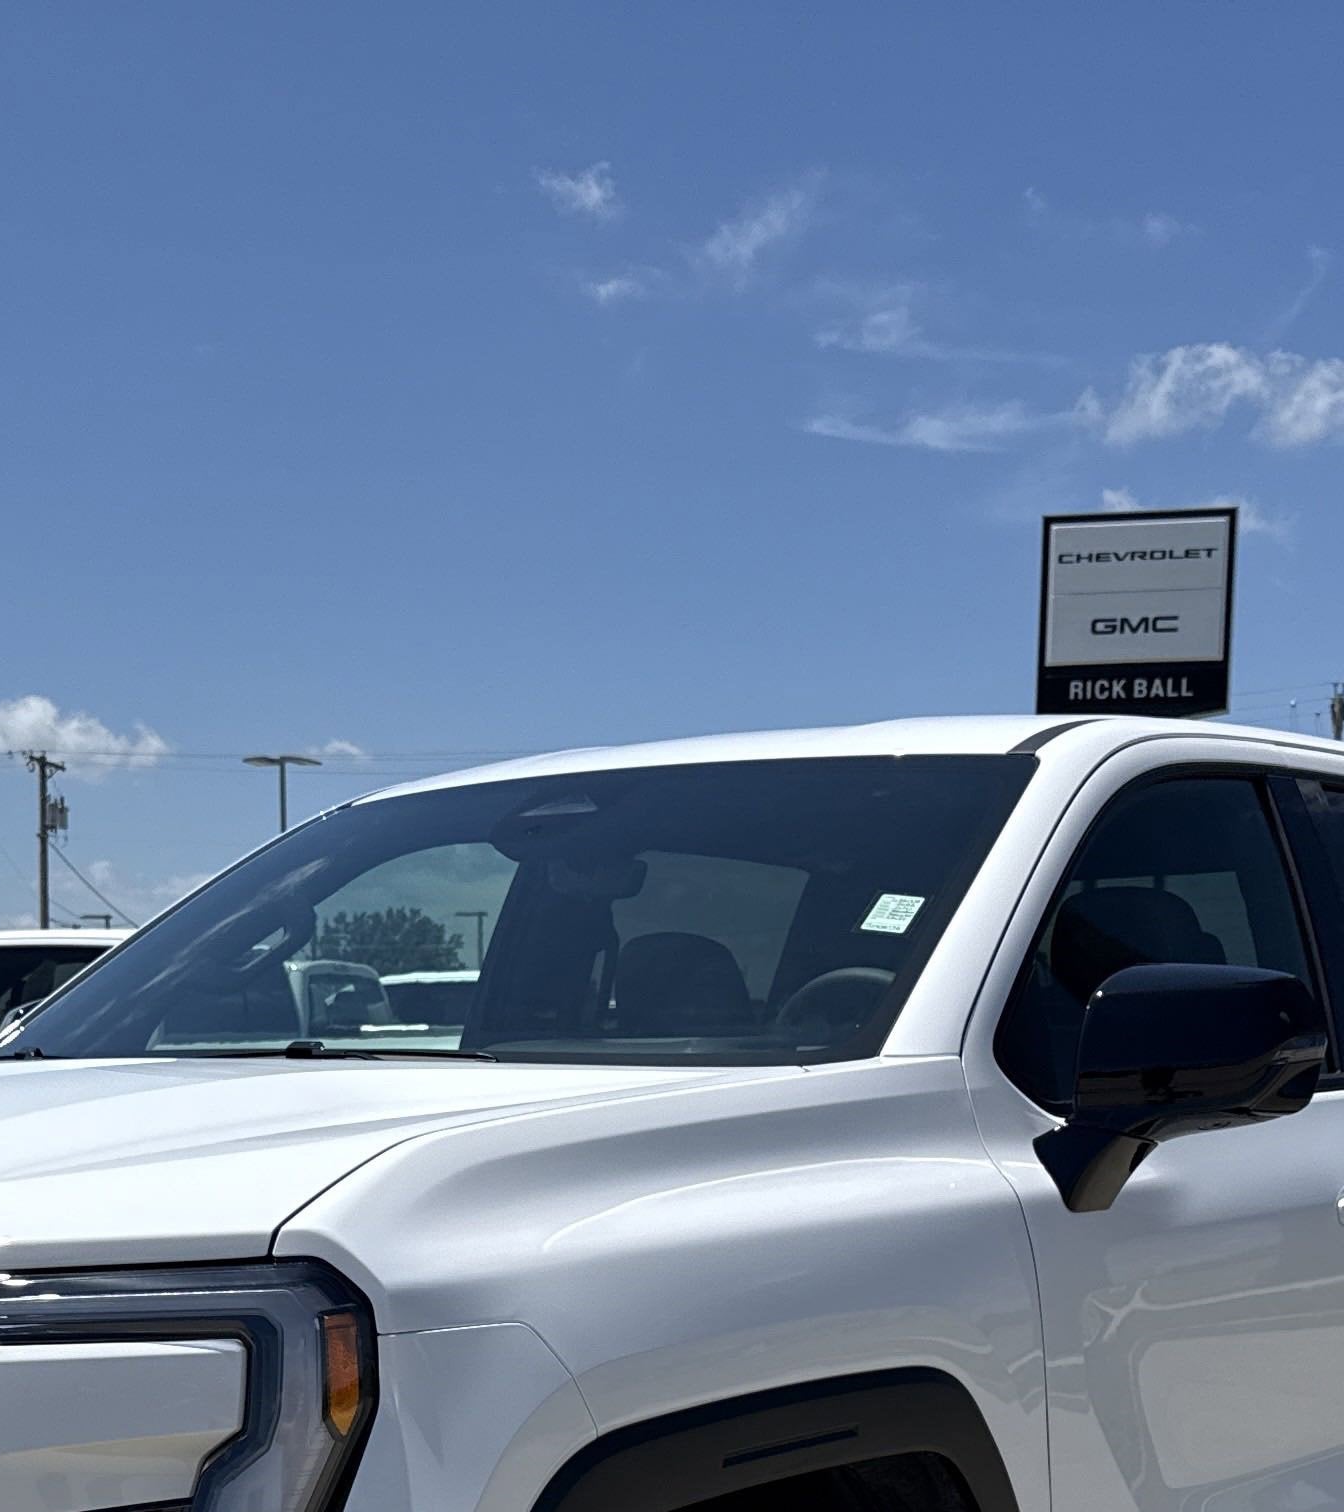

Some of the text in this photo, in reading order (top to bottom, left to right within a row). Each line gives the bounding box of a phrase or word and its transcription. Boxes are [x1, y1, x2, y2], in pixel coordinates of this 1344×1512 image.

[1057, 548, 1218, 565] CHEVROLET
[1090, 616, 1179, 635] GMC
[1068, 677, 1194, 700] RICK BALL
